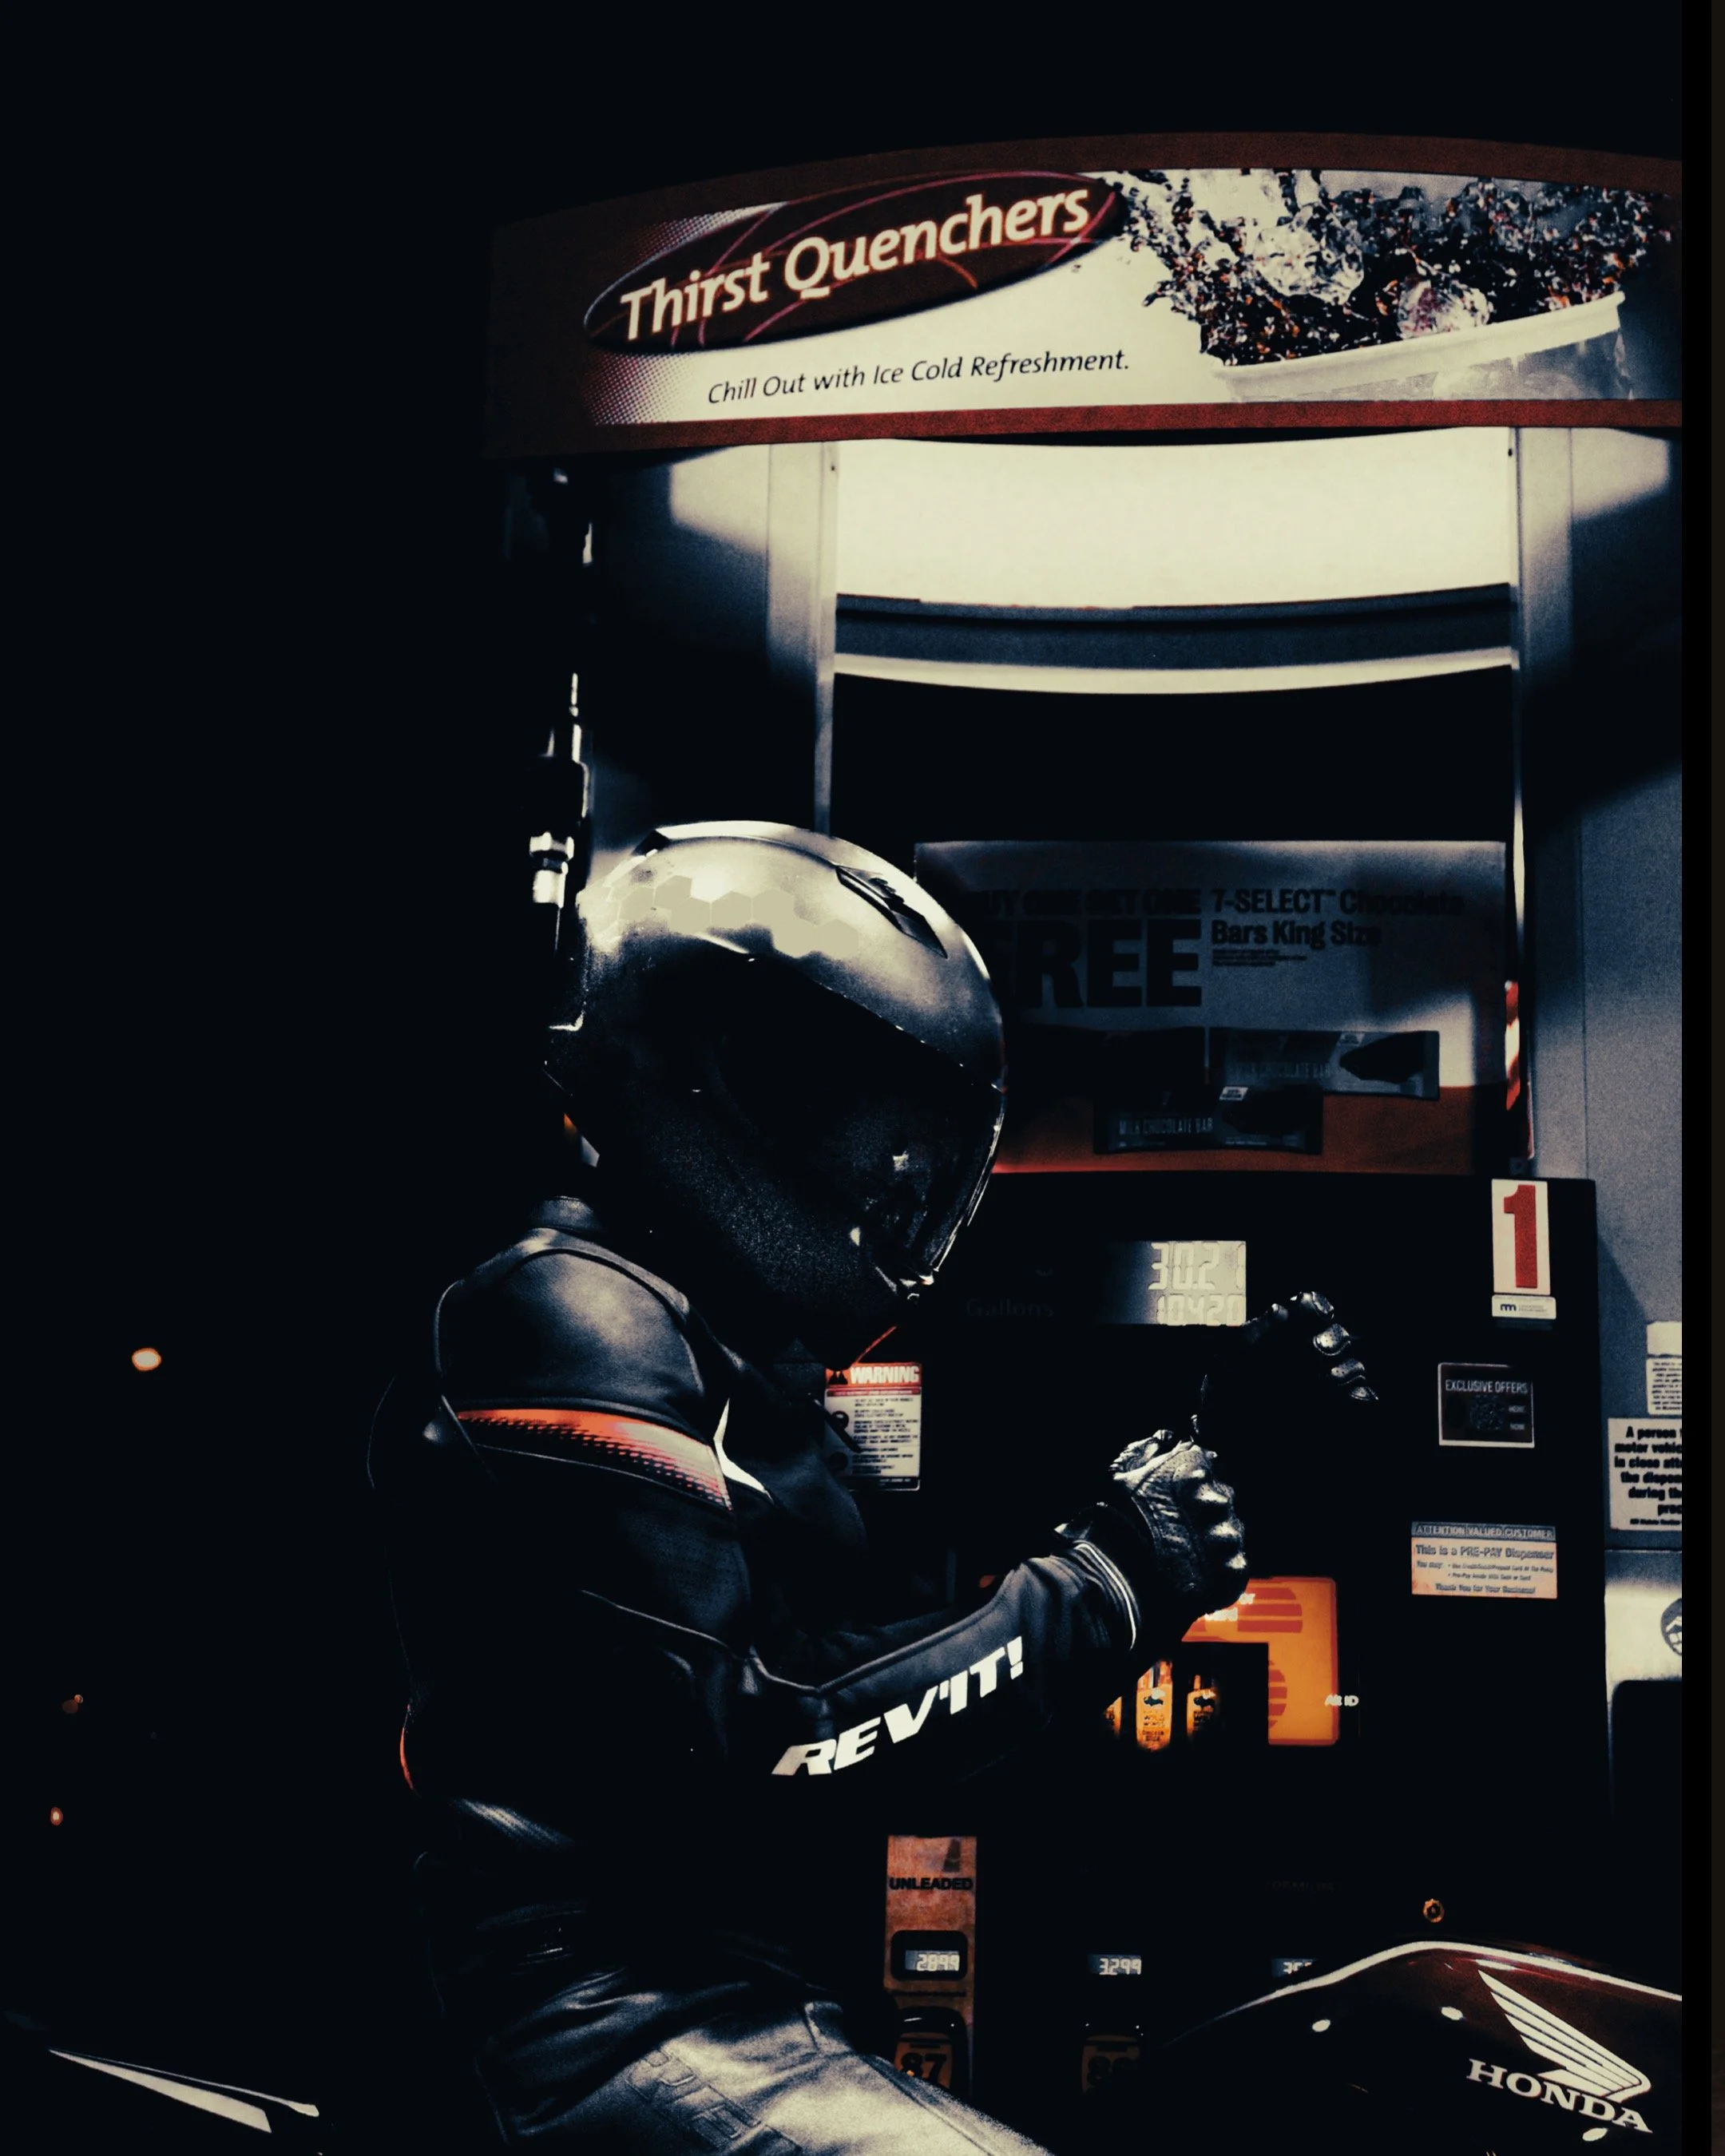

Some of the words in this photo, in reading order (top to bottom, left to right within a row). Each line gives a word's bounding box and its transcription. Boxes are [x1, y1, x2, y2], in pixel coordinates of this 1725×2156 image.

[620, 252, 771, 343] Thirst
[783, 187, 1090, 300] Quenchers
[708, 378, 756, 403] Chill
[763, 373, 805, 396] Out
[814, 366, 866, 390] with
[874, 363, 904, 385] Ice
[911, 358, 962, 380] Cold
[970, 350, 1129, 381] Refreshment.
[1211, 920, 1267, 945] Bars
[1273, 921, 1326, 950] King
[1330, 921, 1382, 945] Size
[1504, 1185, 1537, 1289] 1
[966, 1298, 1054, 1318] Gallons
[850, 1365, 919, 1384] WARNING
[1445, 1379, 1493, 1393] EXCLUSIVE
[1494, 1380, 1529, 1395] OFFERS
[1626, 1426, 1634, 1438] A
[1417, 1524, 1465, 1536] ATTENTION
[1416, 1544, 1436, 1555] This
[1439, 1546, 1448, 1556] is
[1461, 1546, 1502, 1557] PRE-PAY
[771, 1636, 1025, 1777] REV'IT!
[890, 1877, 973, 1890] UNLEADED
[900, 2052, 947, 2085] 87
[1465, 2058, 1653, 2134] HONDA
